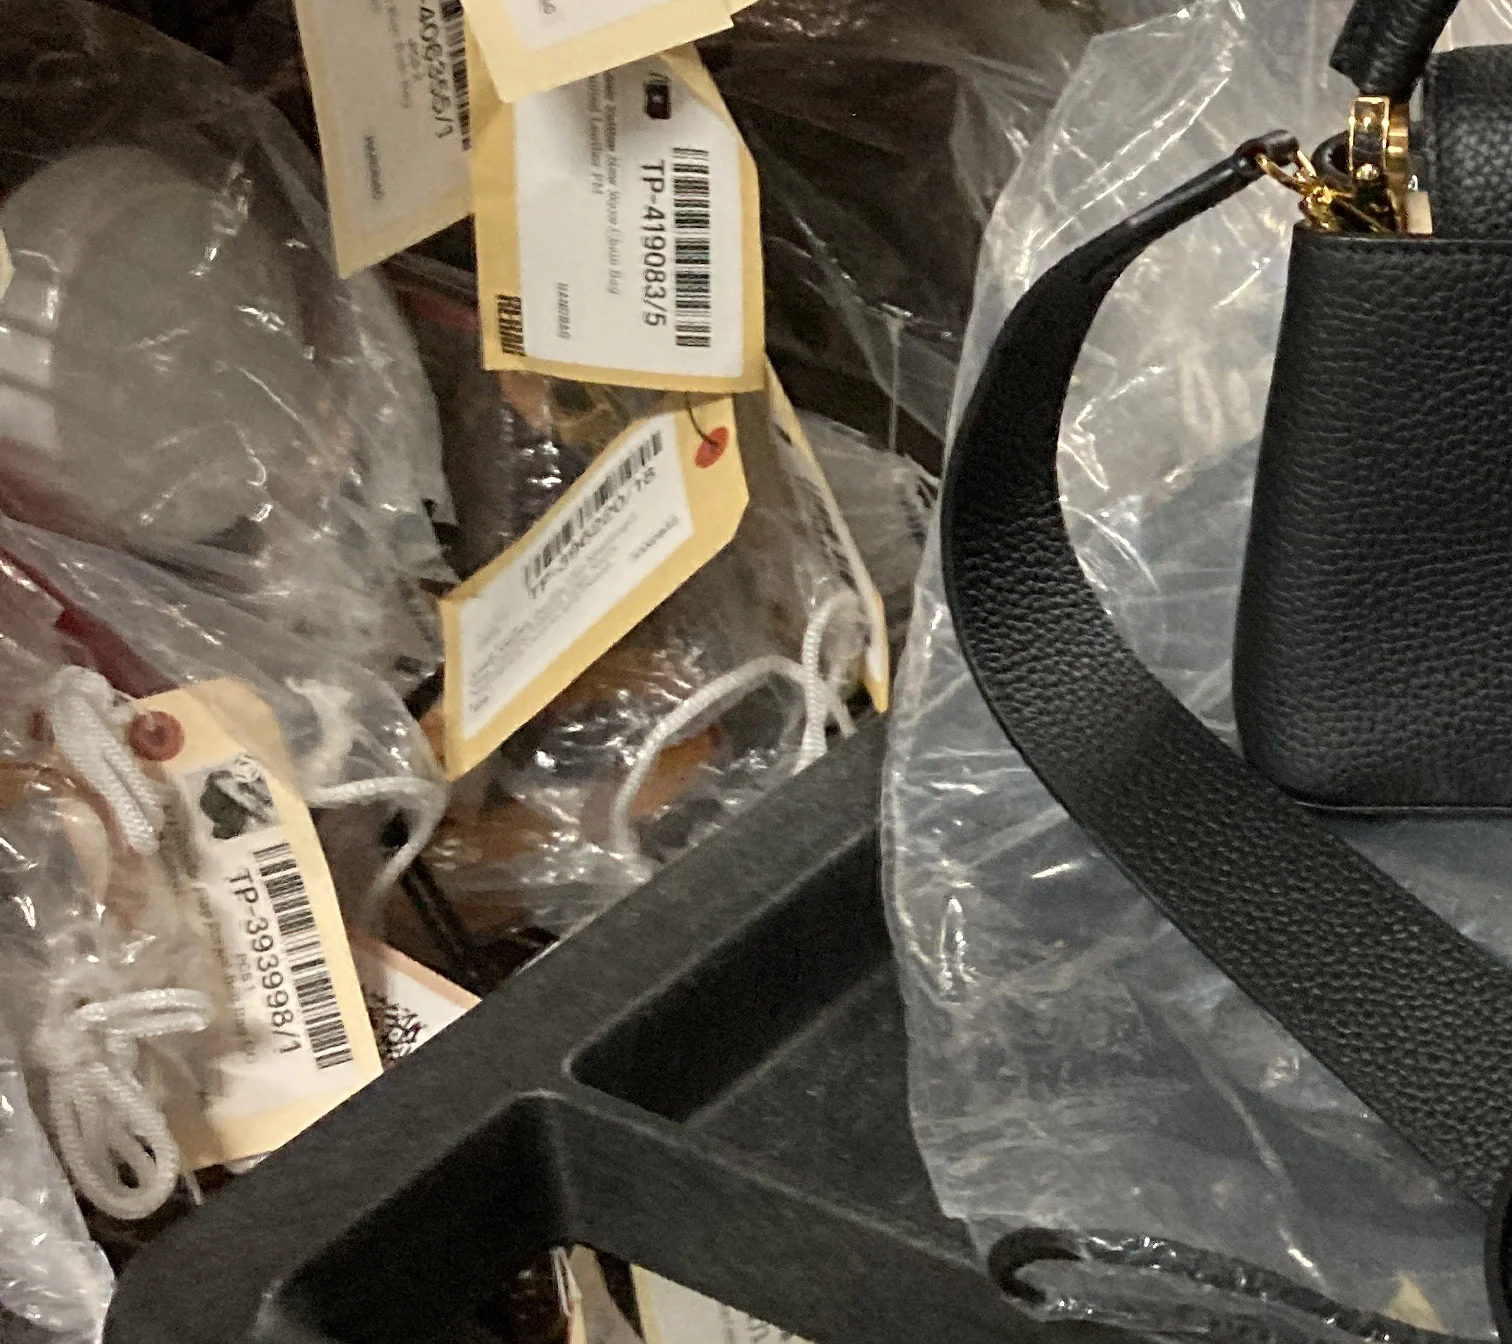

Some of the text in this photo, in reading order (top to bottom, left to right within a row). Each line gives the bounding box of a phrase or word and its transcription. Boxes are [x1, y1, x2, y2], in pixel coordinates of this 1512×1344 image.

[554, 281, 571, 340] HANDBAG
[637, 159, 670, 327] TP-419083/5
[226, 866, 303, 1056] TP-393998/1
